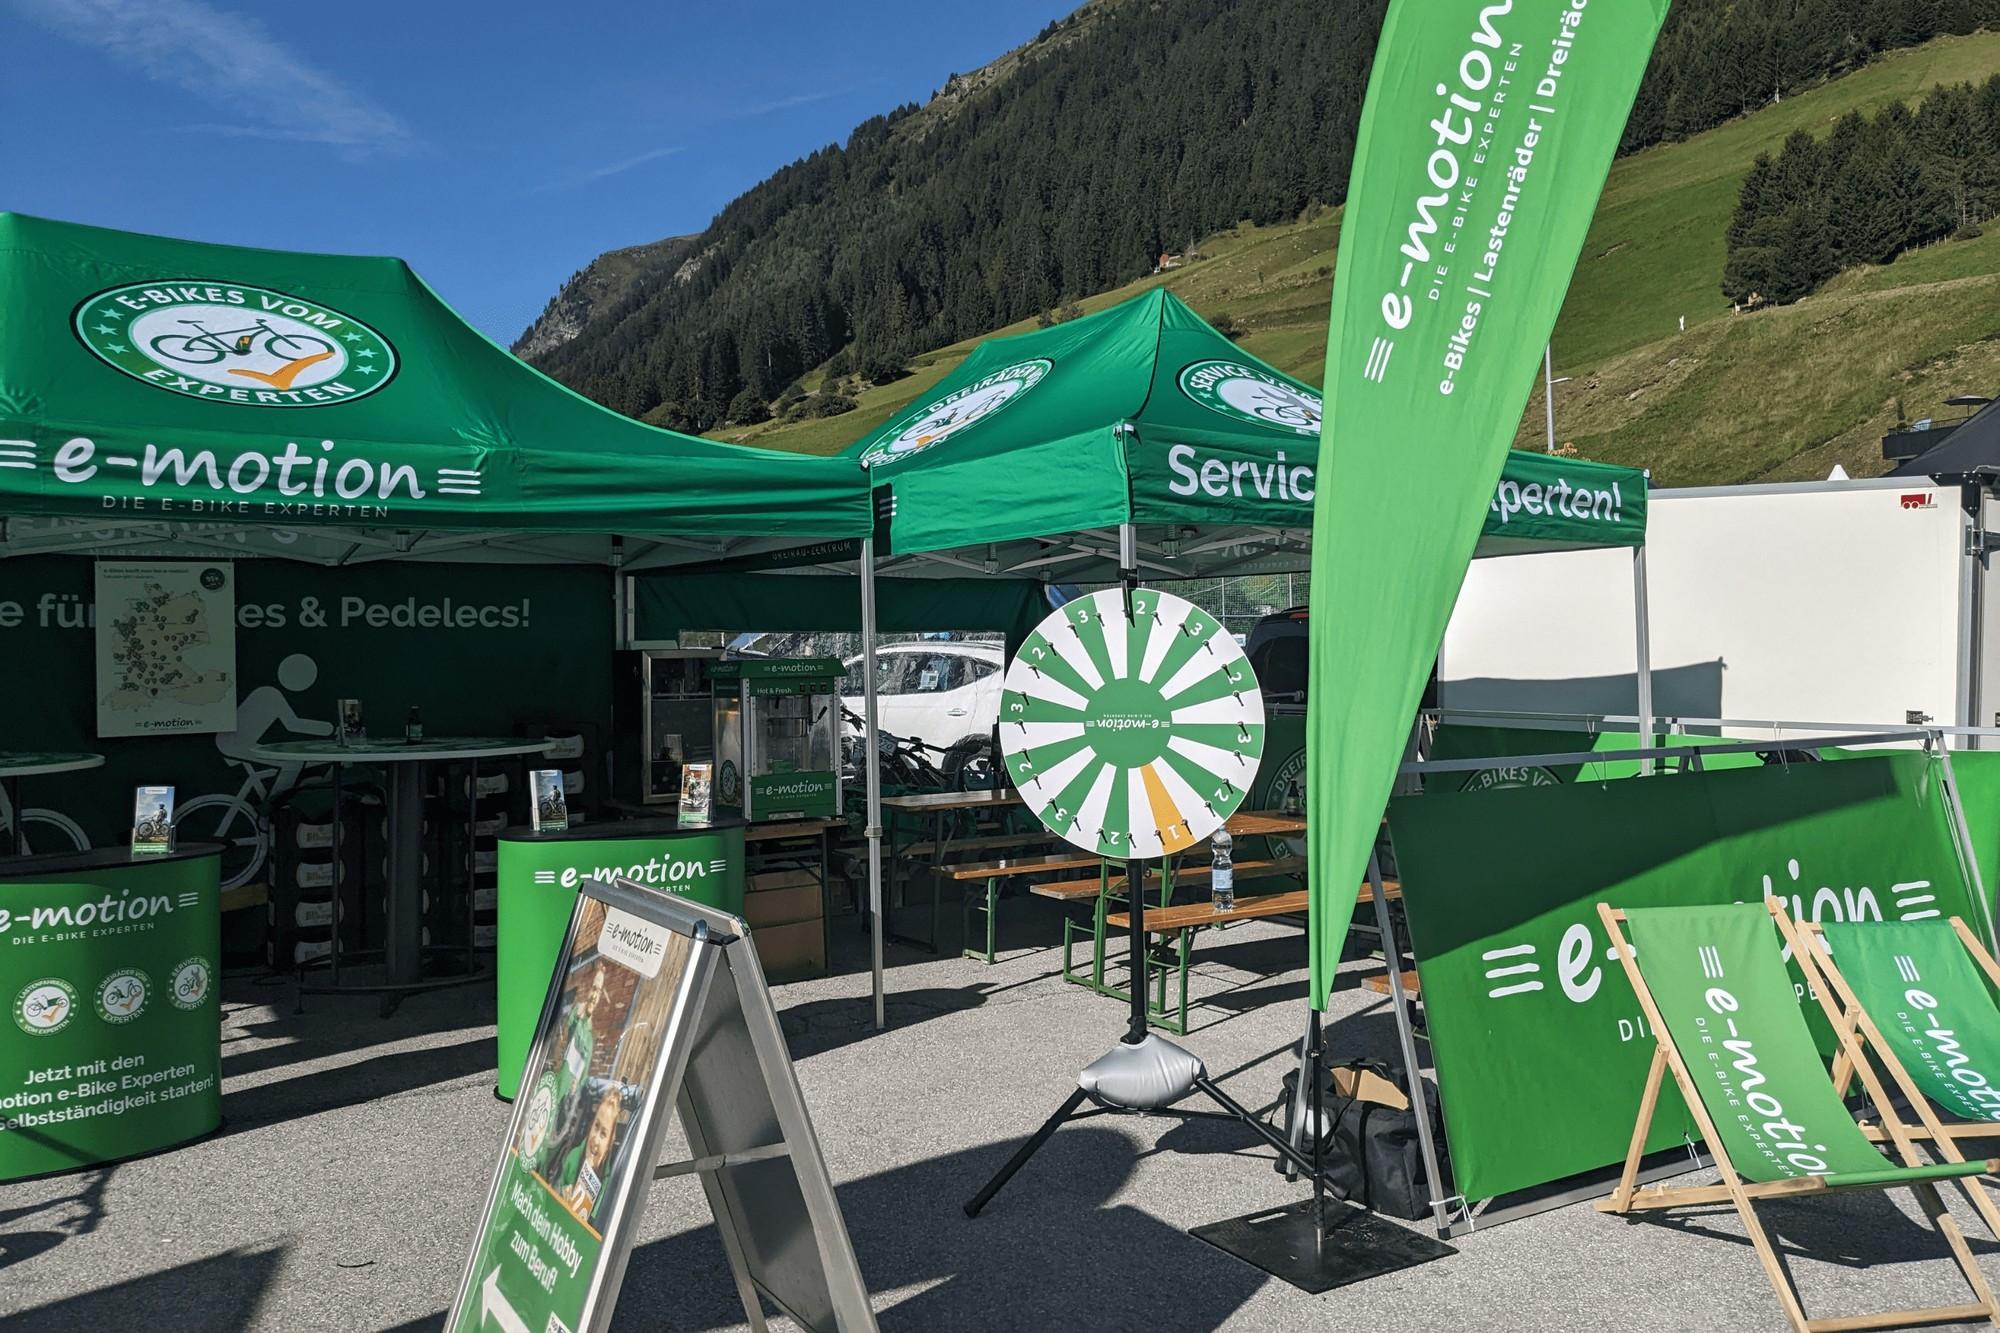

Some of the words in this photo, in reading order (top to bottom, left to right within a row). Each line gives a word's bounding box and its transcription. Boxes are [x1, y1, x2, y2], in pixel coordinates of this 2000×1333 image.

[1382, 0, 1513, 330] e-motion
[1428, 264, 1449, 301] DIE
[1444, 175, 1479, 254] E-BIKE
[1474, 42, 1524, 164] EXPERTEN
[1439, 301, 1482, 396] e-Bikes
[1474, 118, 1544, 283] Lastenräder
[115, 286, 246, 312] E-BIKES
[260, 295, 344, 331] VOM
[142, 367, 356, 405] EXPERTEN
[1189, 365, 1257, 392] SERVICE
[52, 437, 427, 500] e-motion
[1168, 443, 1316, 502] Servic
[1490, 477, 1622, 524] perten!
[102, 494, 146, 511] DIE
[161, 496, 250, 514] E-BIKE
[264, 501, 390, 519] EXPERTEN
[299, 596, 329, 628] &
[341, 596, 530, 628] Pedelecs!
[771, 662, 816, 673] e-motion
[143, 716, 195, 728] e-motion
[1096, 718, 1159, 732] e-motion
[766, 779, 823, 796] e-motion
[560, 853, 706, 888] e-motion
[0, 889, 174, 934] e-motion
[12, 936, 36, 946] DIE
[41, 930, 87, 944] E-BIKE
[93, 922, 155, 938] EXPERTEN
[611, 923, 655, 955] e-motion
[1896, 1011, 1916, 1033] DIE
[1912, 1038, 1946, 1079] E-BIKE
[0, 1090, 52, 1109] otion
[57, 1077, 118, 1100] e-Bike
[121, 1063, 196, 1090] Experten
[24, 1067, 72, 1086] Jetzt
[76, 1060, 108, 1078] mit
[111, 1053, 145, 1072] den
[159, 1073, 215, 1103] starten!
[1695, 1017, 1713, 1044] DIE
[1708, 1052, 1741, 1107] E-BIKE
[1737, 1114, 1799, 1177] EXPERTEN
[510, 1179, 533, 1222] Mach
[530, 1204, 552, 1242] dein
[548, 1222, 584, 1280] Hobby
[510, 1229, 531, 1264] zum
[528, 1245, 559, 1295] Beruf!
